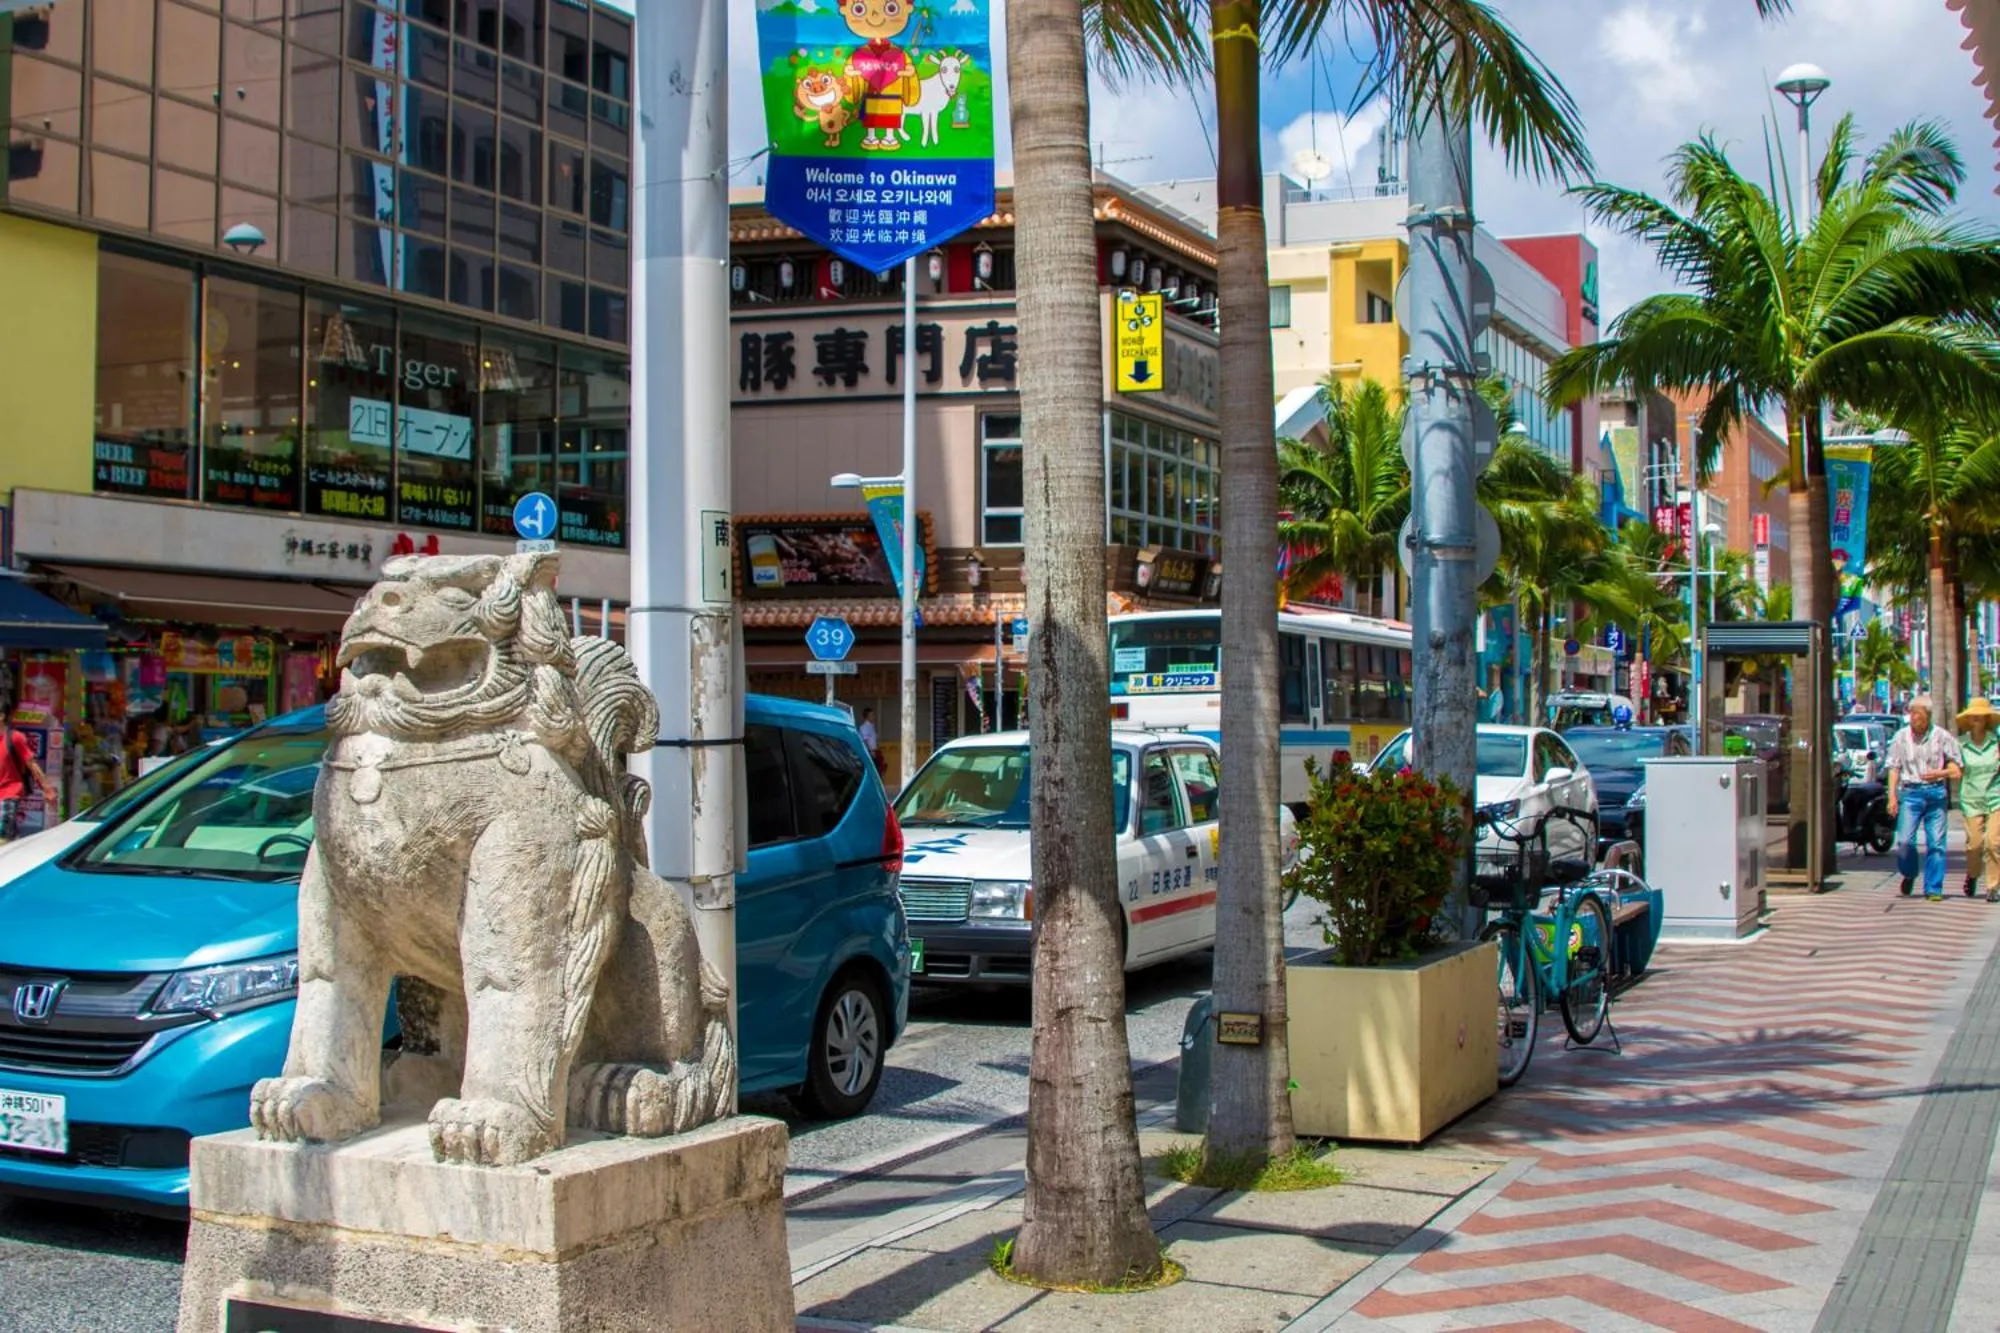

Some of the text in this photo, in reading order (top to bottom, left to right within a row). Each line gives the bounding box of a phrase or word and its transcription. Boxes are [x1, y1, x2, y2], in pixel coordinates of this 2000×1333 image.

[805, 167, 957, 186] Welcome to Okinawa
[806, 187, 953, 206] 어서 오세요 오키나와에
[815, 628, 845, 646] 39
[1128, 880, 1138, 901] 22
